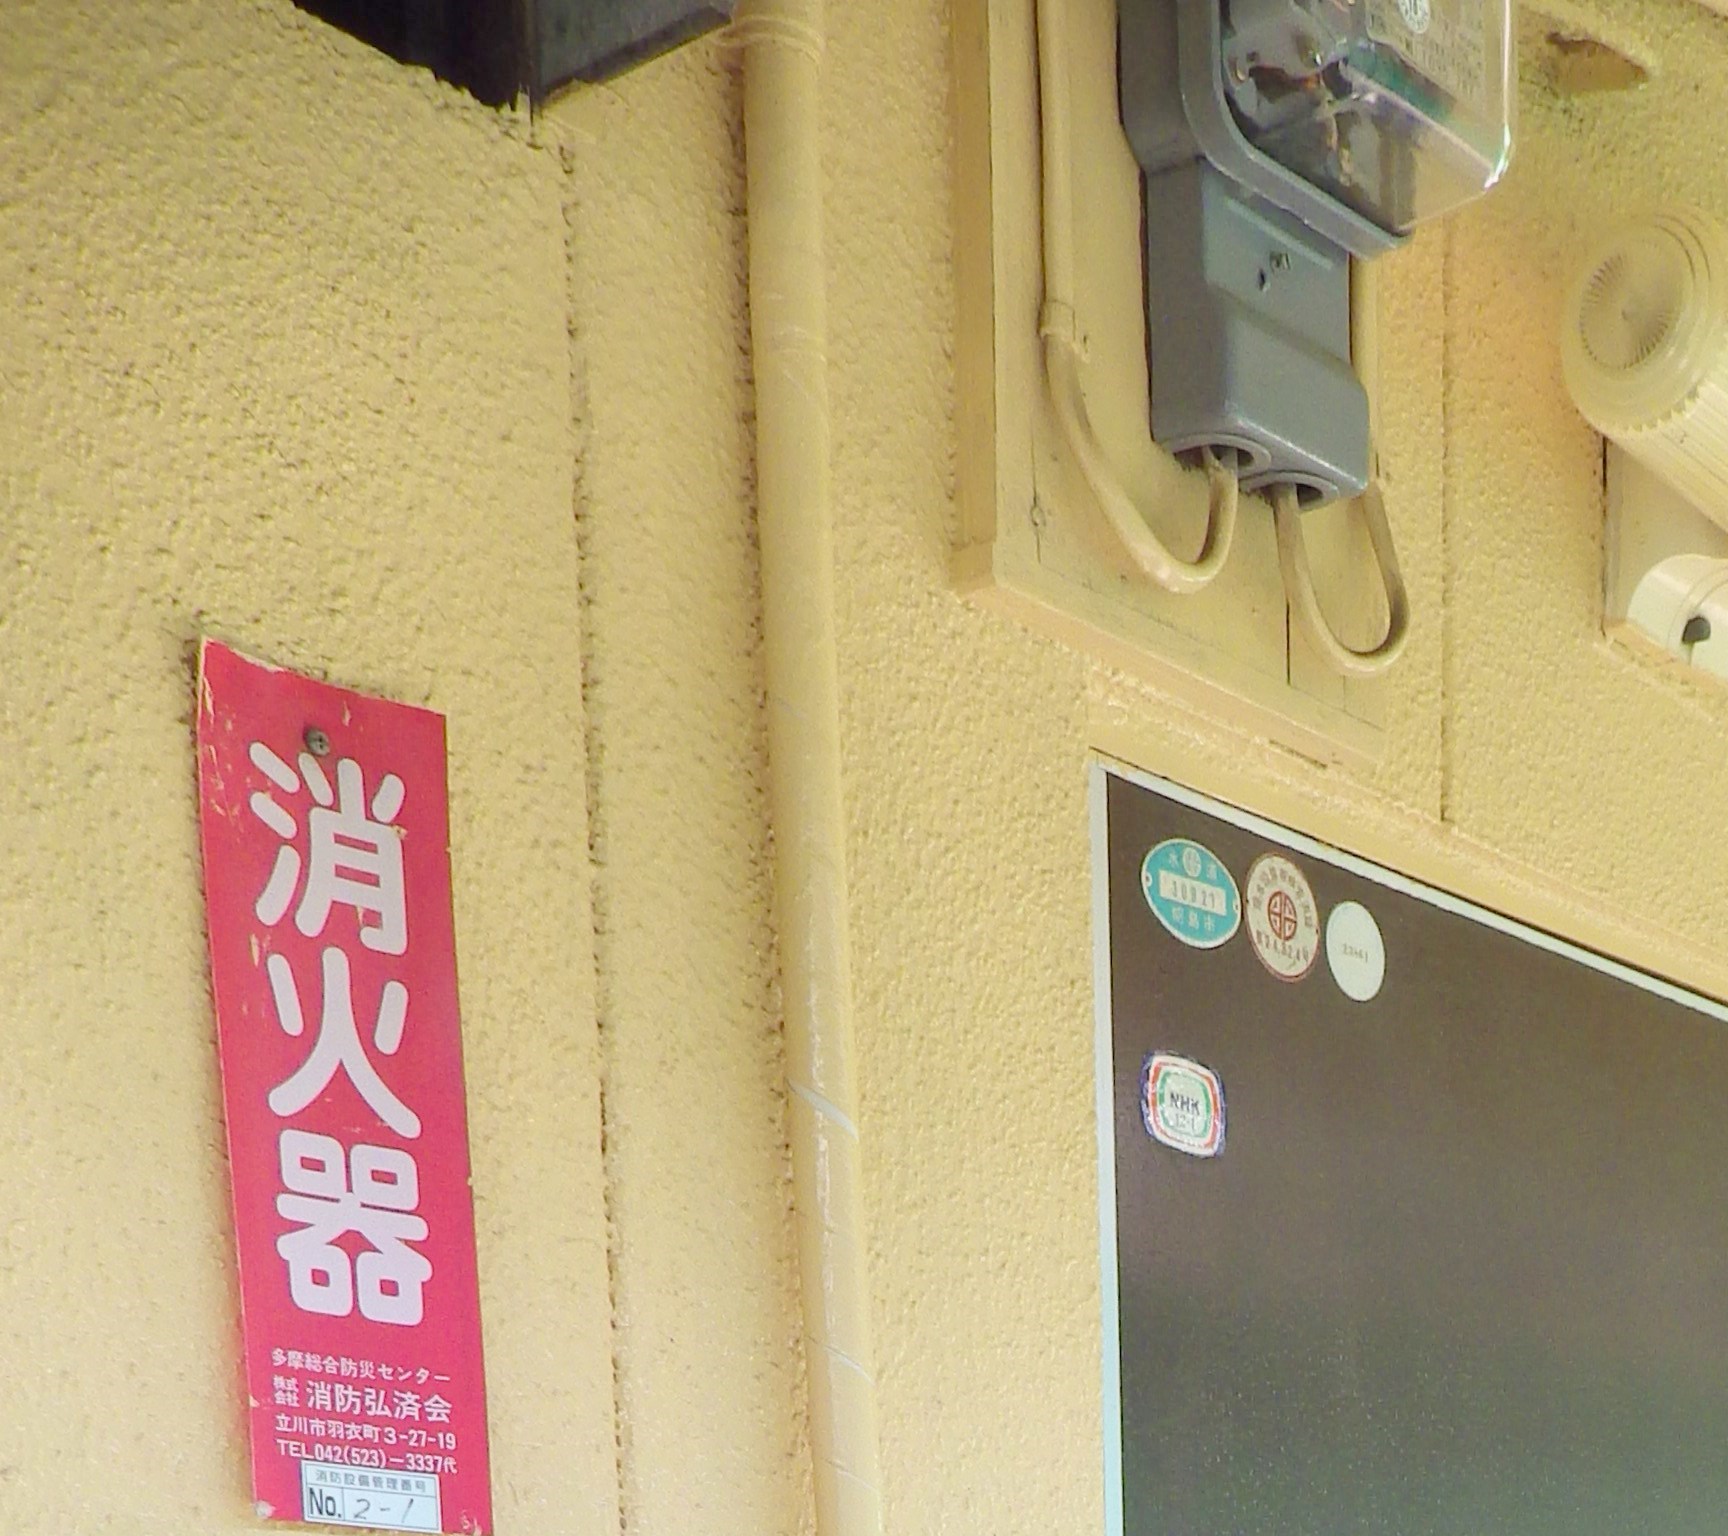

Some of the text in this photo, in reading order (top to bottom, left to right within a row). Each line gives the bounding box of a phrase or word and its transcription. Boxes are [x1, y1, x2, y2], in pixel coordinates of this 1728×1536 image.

[248, 737, 433, 1327] 消火器
[1170, 1092, 1201, 1117] NHK
[271, 1347, 452, 1386] 多摩総合防災センター
[306, 1379, 453, 1424] 消防弘済会
[308, 1486, 343, 1519] No.
